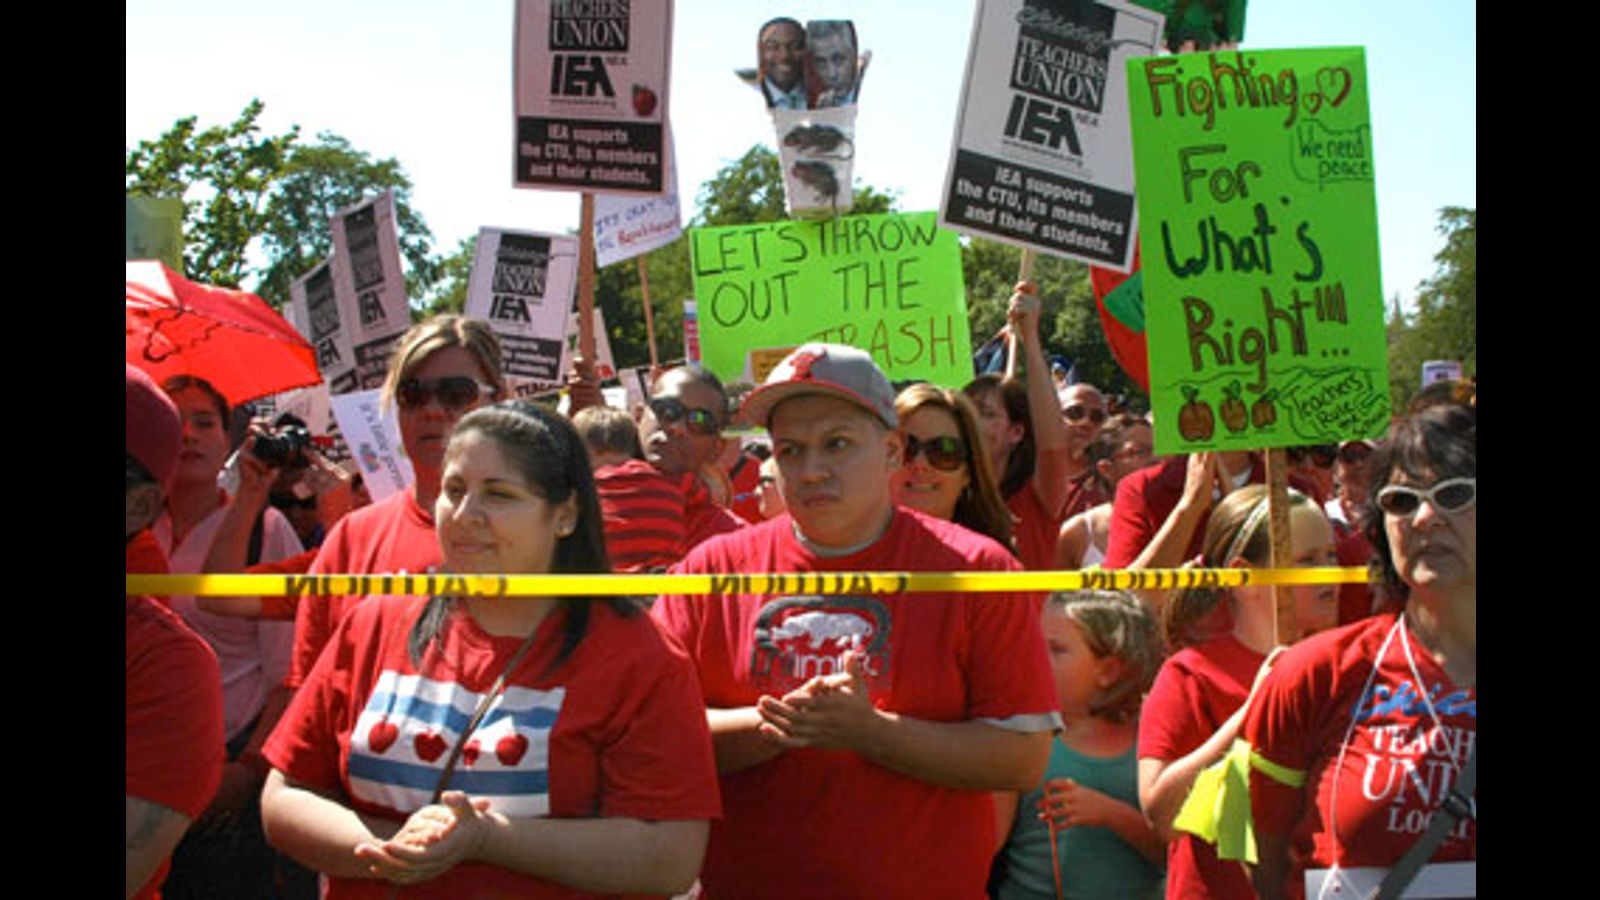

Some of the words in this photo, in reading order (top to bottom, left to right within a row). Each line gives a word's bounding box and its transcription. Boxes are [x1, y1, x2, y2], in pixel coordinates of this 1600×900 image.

[553, 19, 626, 47] UNION
[1020, 34, 1108, 80] TEACHERS
[551, 54, 615, 97] IEA
[1014, 55, 1102, 108] UNION
[1144, 51, 1298, 132] Fighting
[547, 123, 569, 140] IEA
[1003, 94, 1084, 157] IEA
[995, 166, 1022, 189] IEA
[1025, 175, 1095, 207] supports
[1178, 143, 1263, 203] For
[956, 177, 983, 199] the
[986, 186, 1023, 212] CTU,
[1026, 196, 1048, 215] its
[1051, 204, 1125, 236] members
[964, 203, 995, 225] and
[999, 211, 1037, 233] their
[692, 224, 809, 277] LET'S
[810, 216, 938, 257] THROW
[1160, 197, 1324, 283] What's
[489, 295, 533, 323] IEA
[711, 269, 799, 328] OUT
[832, 256, 921, 312] THE
